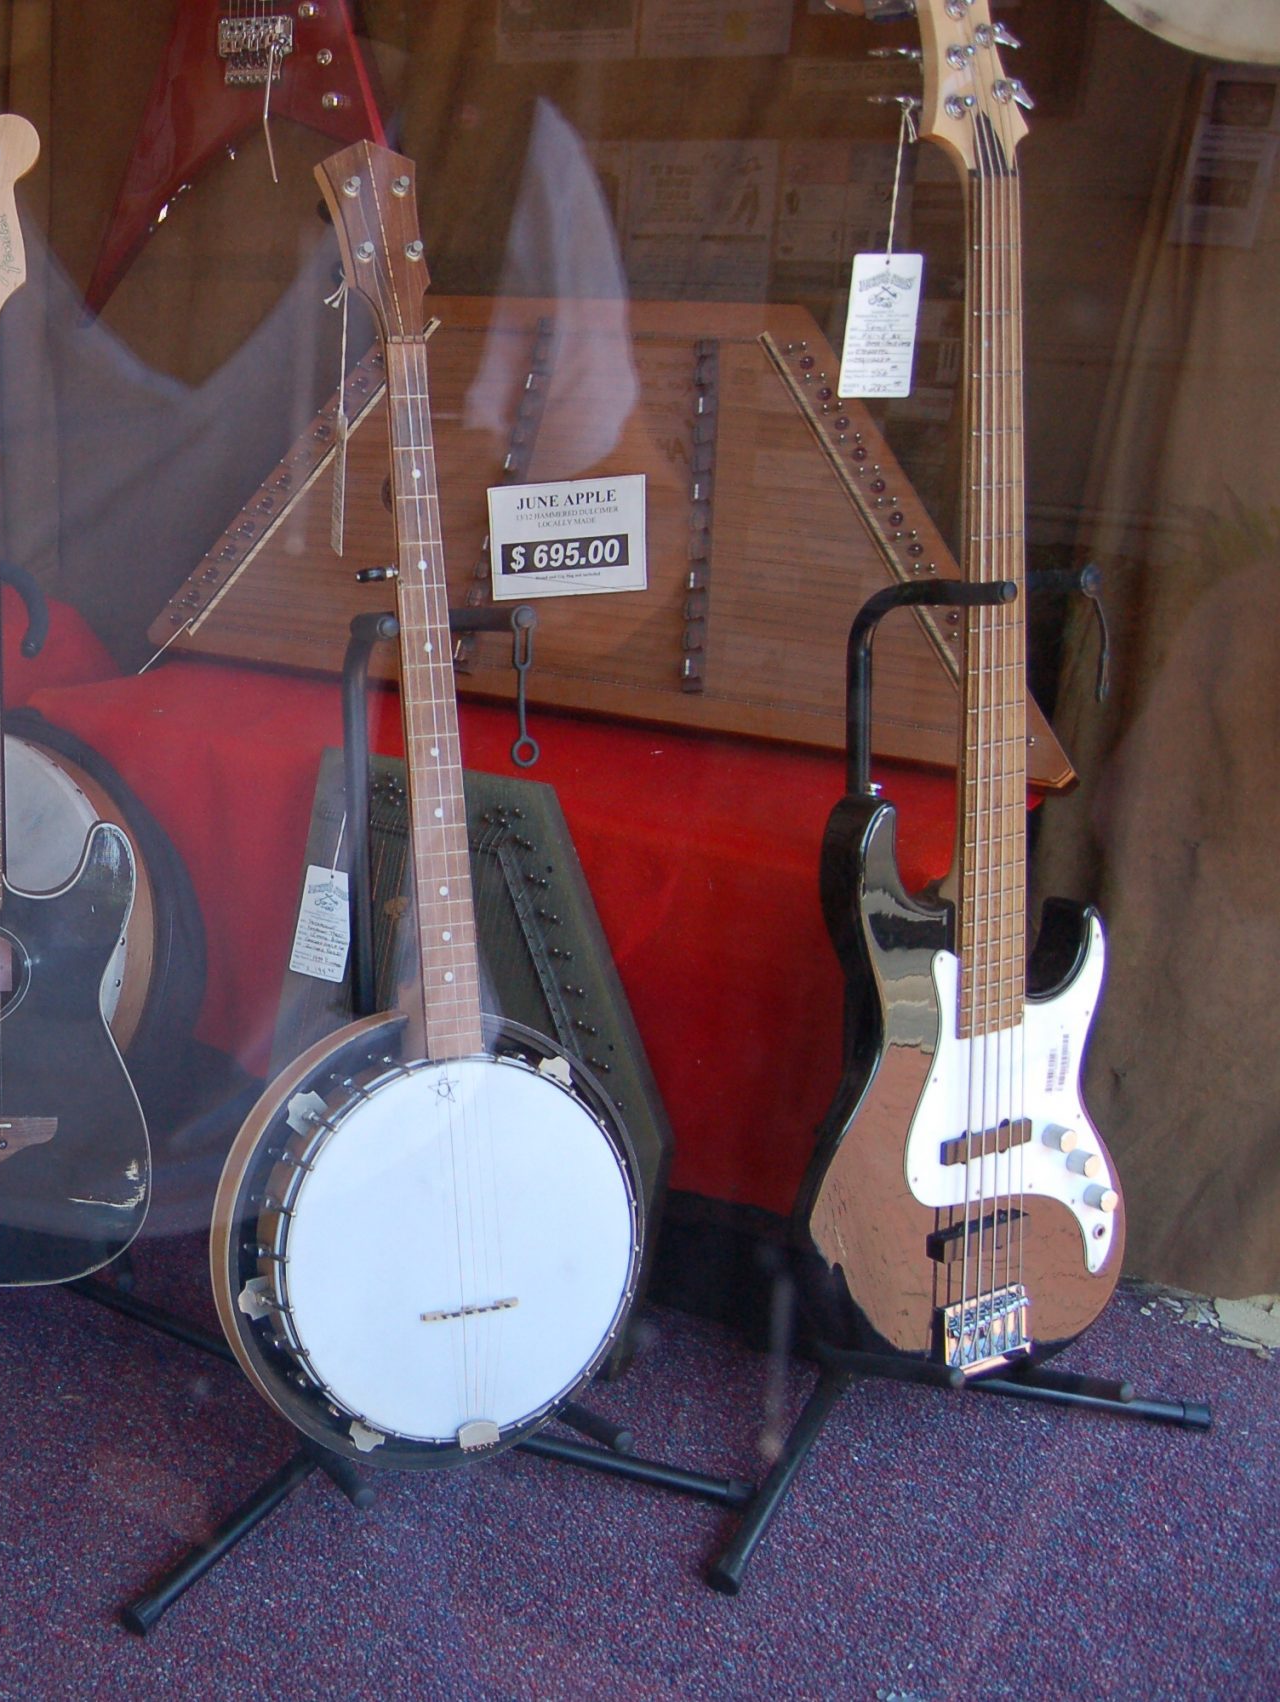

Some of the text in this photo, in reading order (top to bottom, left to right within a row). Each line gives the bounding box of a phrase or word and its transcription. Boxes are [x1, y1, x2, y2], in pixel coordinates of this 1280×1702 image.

[516, 489, 617, 511] JUNE APPLE
[534, 510, 577, 520] HAMMERED
[579, 506, 619, 516] DULCIMER
[538, 517, 596, 528] LOCALLY MADE
[510, 538, 620, 572] $ 695.00
